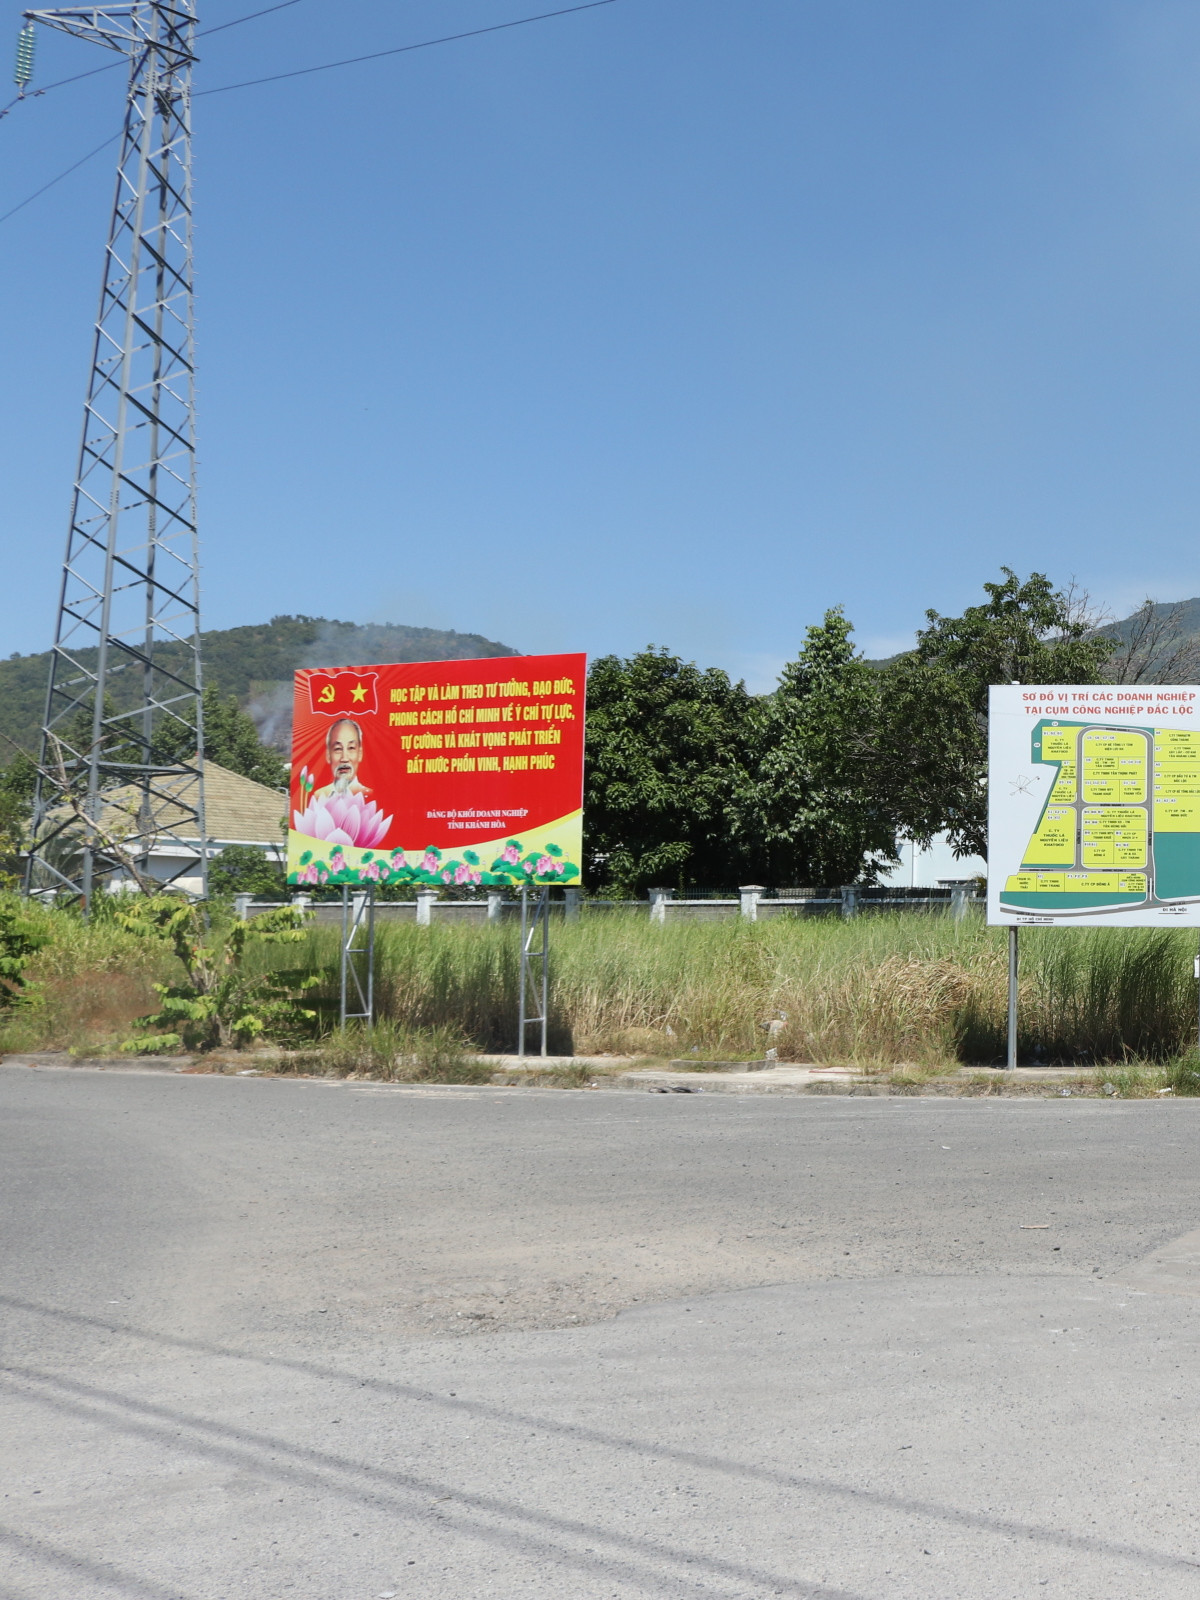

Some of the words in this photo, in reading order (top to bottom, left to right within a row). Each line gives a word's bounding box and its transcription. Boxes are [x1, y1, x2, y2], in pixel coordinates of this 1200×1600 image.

[390, 688, 407, 705] HỌC
[410, 685, 426, 704] TẬP
[428, 684, 439, 700] VÀ
[441, 683, 459, 700] LÀM
[462, 684, 483, 699] THEO
[486, 683, 498, 698] TƯ
[498, 678, 530, 697] TƯỞNG,
[533, 681, 551, 698] ĐẠO
[554, 677, 575, 695] ĐỨC,
[1022, 692, 1036, 701] SƠ
[1058, 693, 1068, 702] VỊ
[1072, 692, 1089, 701] TRÍ
[1092, 691, 1113, 701] CÁC
[1156, 691, 1196, 702] NGHIỆP
[389, 712, 418, 726] PHONG
[420, 708, 442, 725] CÁCH
[459, 706, 474, 723] CHÍ
[476, 708, 500, 722] MINH
[515, 704, 521, 720] Ý
[523, 703, 538, 720] CHÍ
[541, 705, 553, 722] TỰ
[554, 703, 575, 722] LỰC,
[1025, 706, 1042, 716] TẠI
[1045, 706, 1068, 716] CỤM
[1073, 705, 1101, 714] CÔNG
[1105, 705, 1143, 716] NGHIỆP
[1173, 705, 1193, 716] LỘC
[401, 735, 413, 752] TỰ
[414, 732, 442, 749] CƯỜNG
[445, 731, 456, 748] VÀ
[458, 730, 480, 747] KHÁT
[483, 732, 506, 749] VỌNG
[509, 728, 531, 745] PHÁT
[534, 724, 561, 744] TRIỂN
[407, 755, 423, 773] ĐẤT
[426, 756, 449, 772] NƯỚC
[478, 757, 501, 772] VINH,
[503, 756, 528, 773] HẠNH
[530, 752, 555, 769] PHÚC
